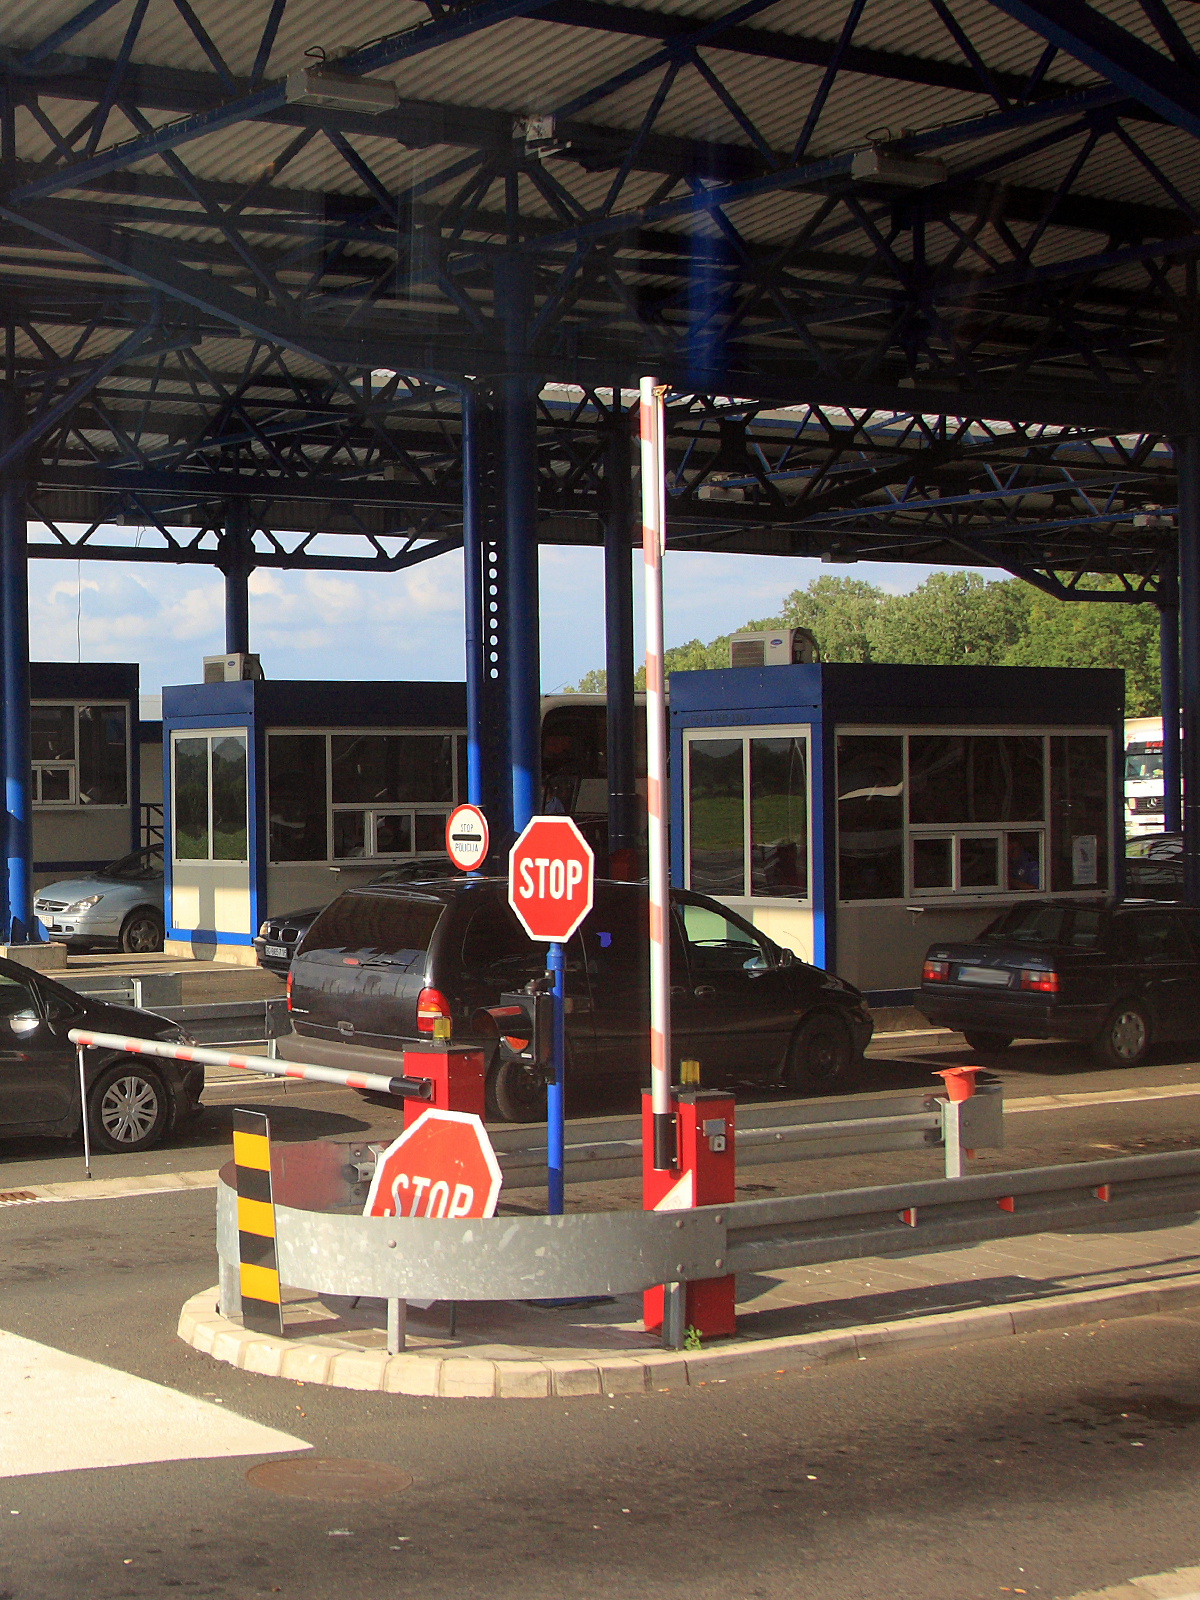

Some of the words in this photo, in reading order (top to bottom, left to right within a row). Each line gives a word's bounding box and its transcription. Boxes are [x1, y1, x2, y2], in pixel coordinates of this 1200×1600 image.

[460, 823, 474, 833] STOP
[455, 842, 479, 853] POLICIJA
[519, 857, 583, 901] STOP
[384, 1173, 474, 1218] STOP
